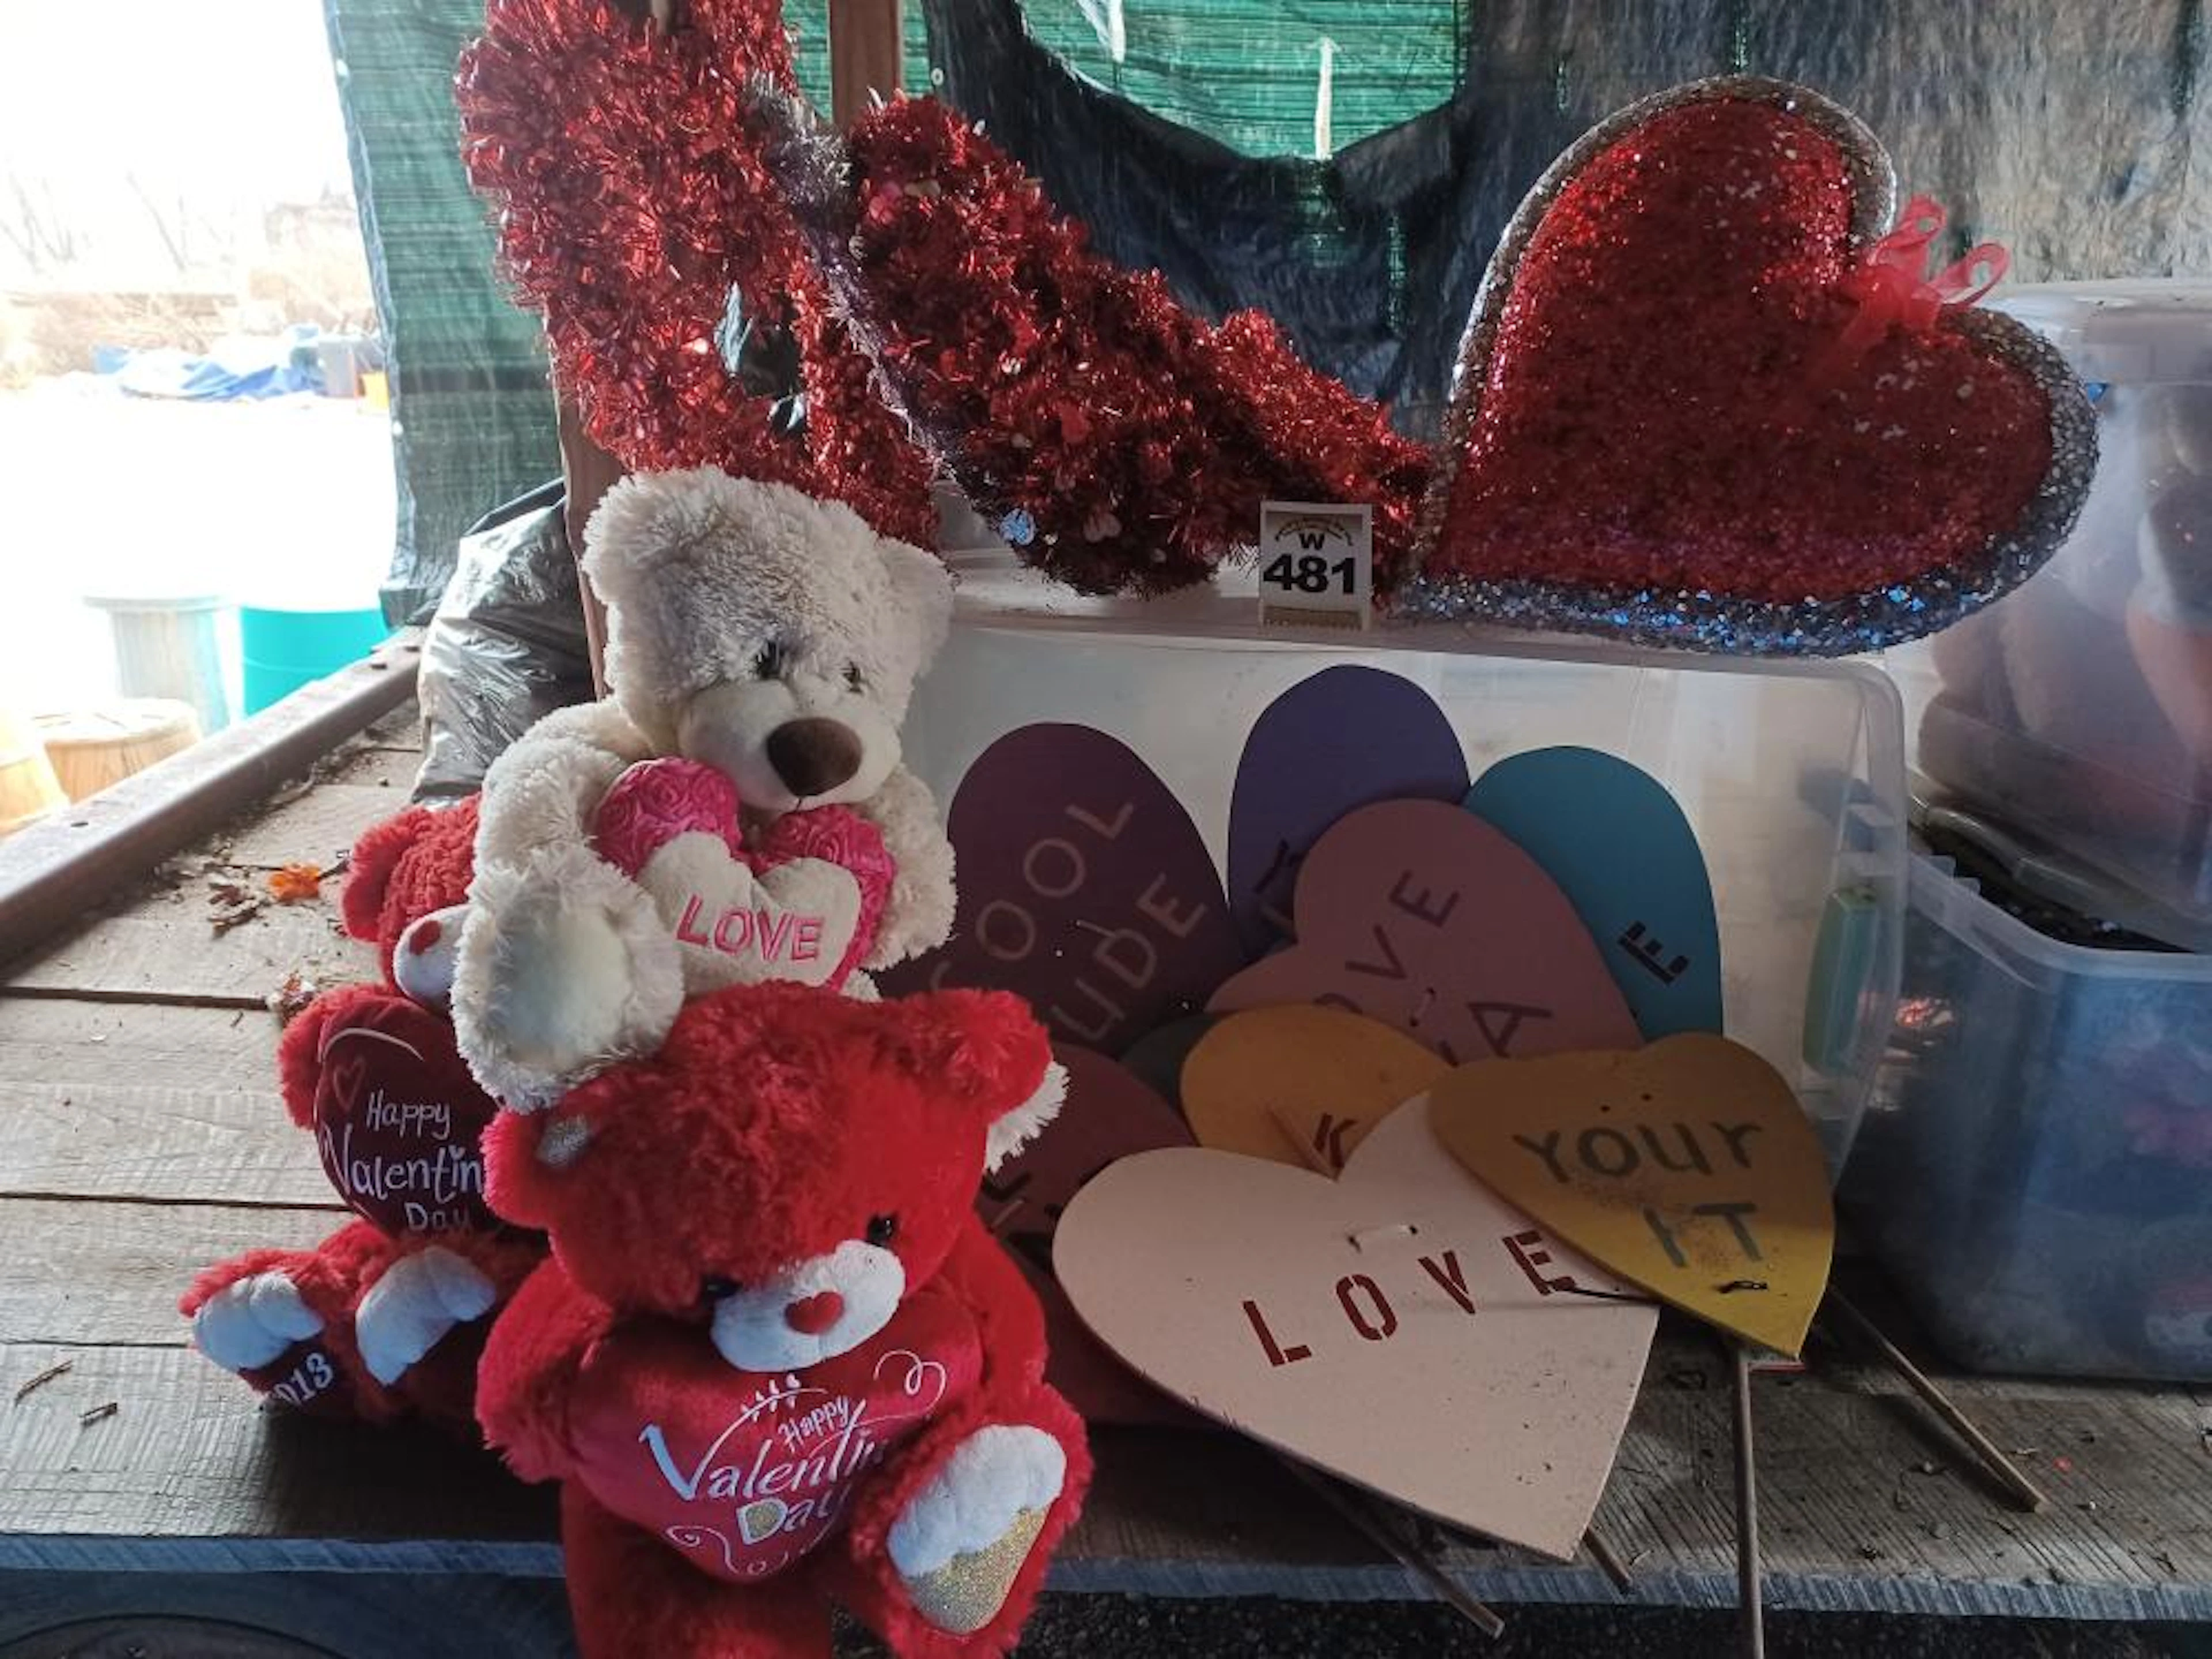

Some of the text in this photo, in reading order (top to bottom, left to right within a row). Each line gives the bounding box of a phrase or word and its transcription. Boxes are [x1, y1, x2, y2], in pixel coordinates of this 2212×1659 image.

[1298, 532, 1325, 550] W
[1263, 554, 1355, 594] 481
[675, 892, 825, 964] LOVE
[1050, 870, 1207, 1043] UDE
[366, 1089, 450, 1141] Happy
[323, 1122, 483, 1205] Valentin
[1642, 1202, 1759, 1268] IT
[1241, 1229, 1575, 1368] LOVE
[267, 1352, 334, 1408] 013
[778, 1395, 850, 1454] Happy
